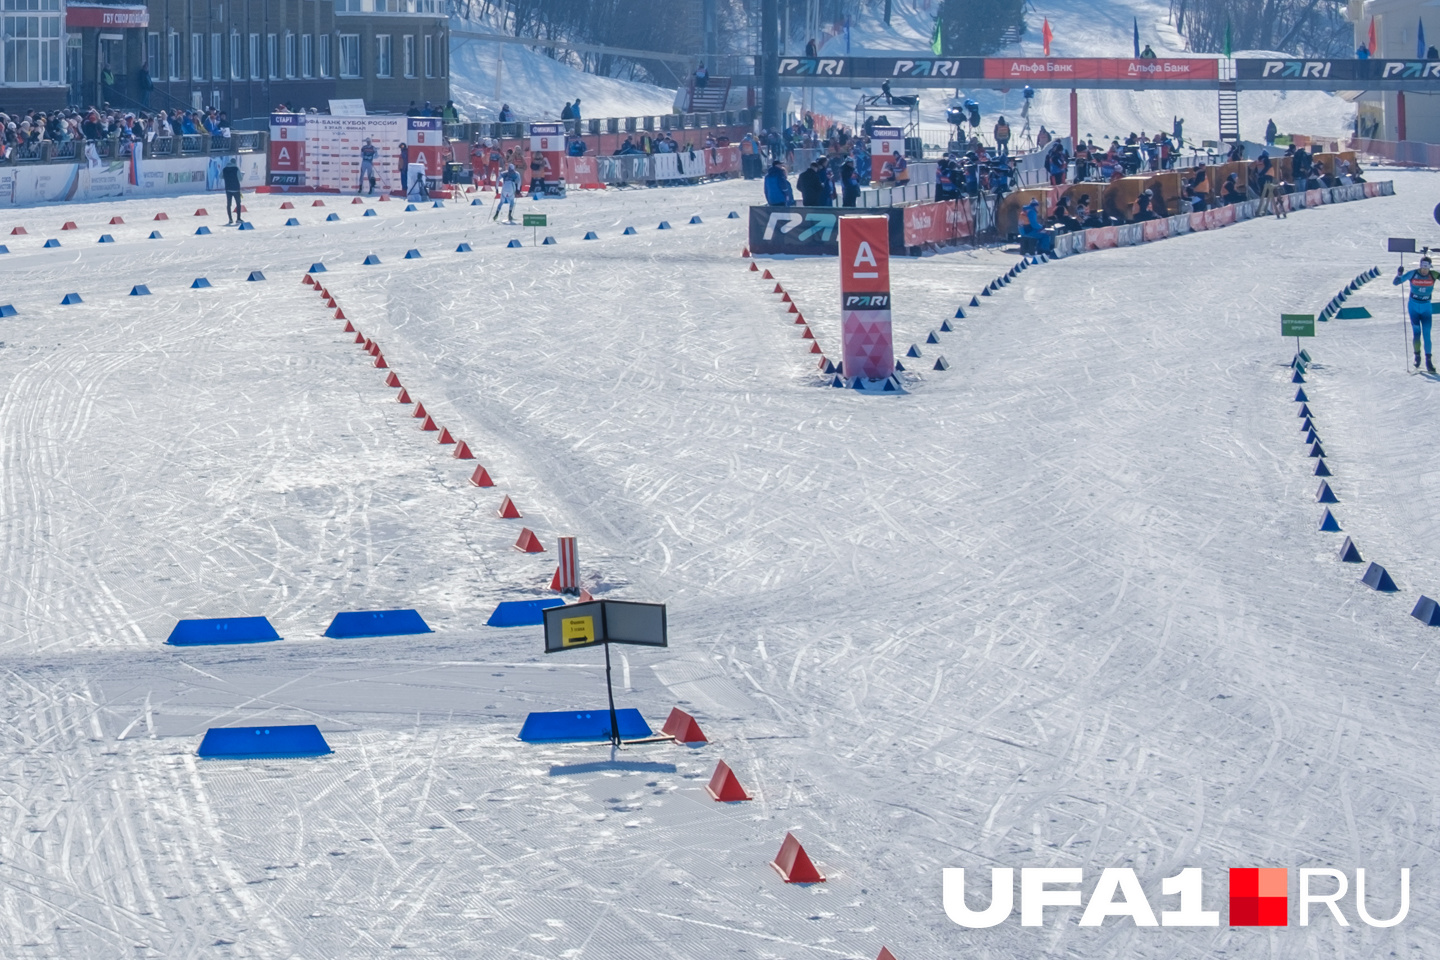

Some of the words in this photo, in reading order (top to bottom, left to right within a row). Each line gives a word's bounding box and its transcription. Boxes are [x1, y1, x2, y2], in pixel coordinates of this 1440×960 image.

[778, 59, 844, 75] PARI
[893, 60, 960, 76] PARI
[1011, 62, 1045, 74] Альфа
[1047, 62, 1072, 72] Банк
[1127, 62, 1162, 74] Альфа
[1164, 62, 1190, 72] Банк
[1262, 61, 1332, 78] PARI
[275, 116, 293, 124] СТАРТ
[412, 120, 430, 128] СТАРТ
[532, 125, 557, 134] ФИНИШ
[873, 129, 899, 137] ФИНИШ
[846, 295, 888, 307] PARI
